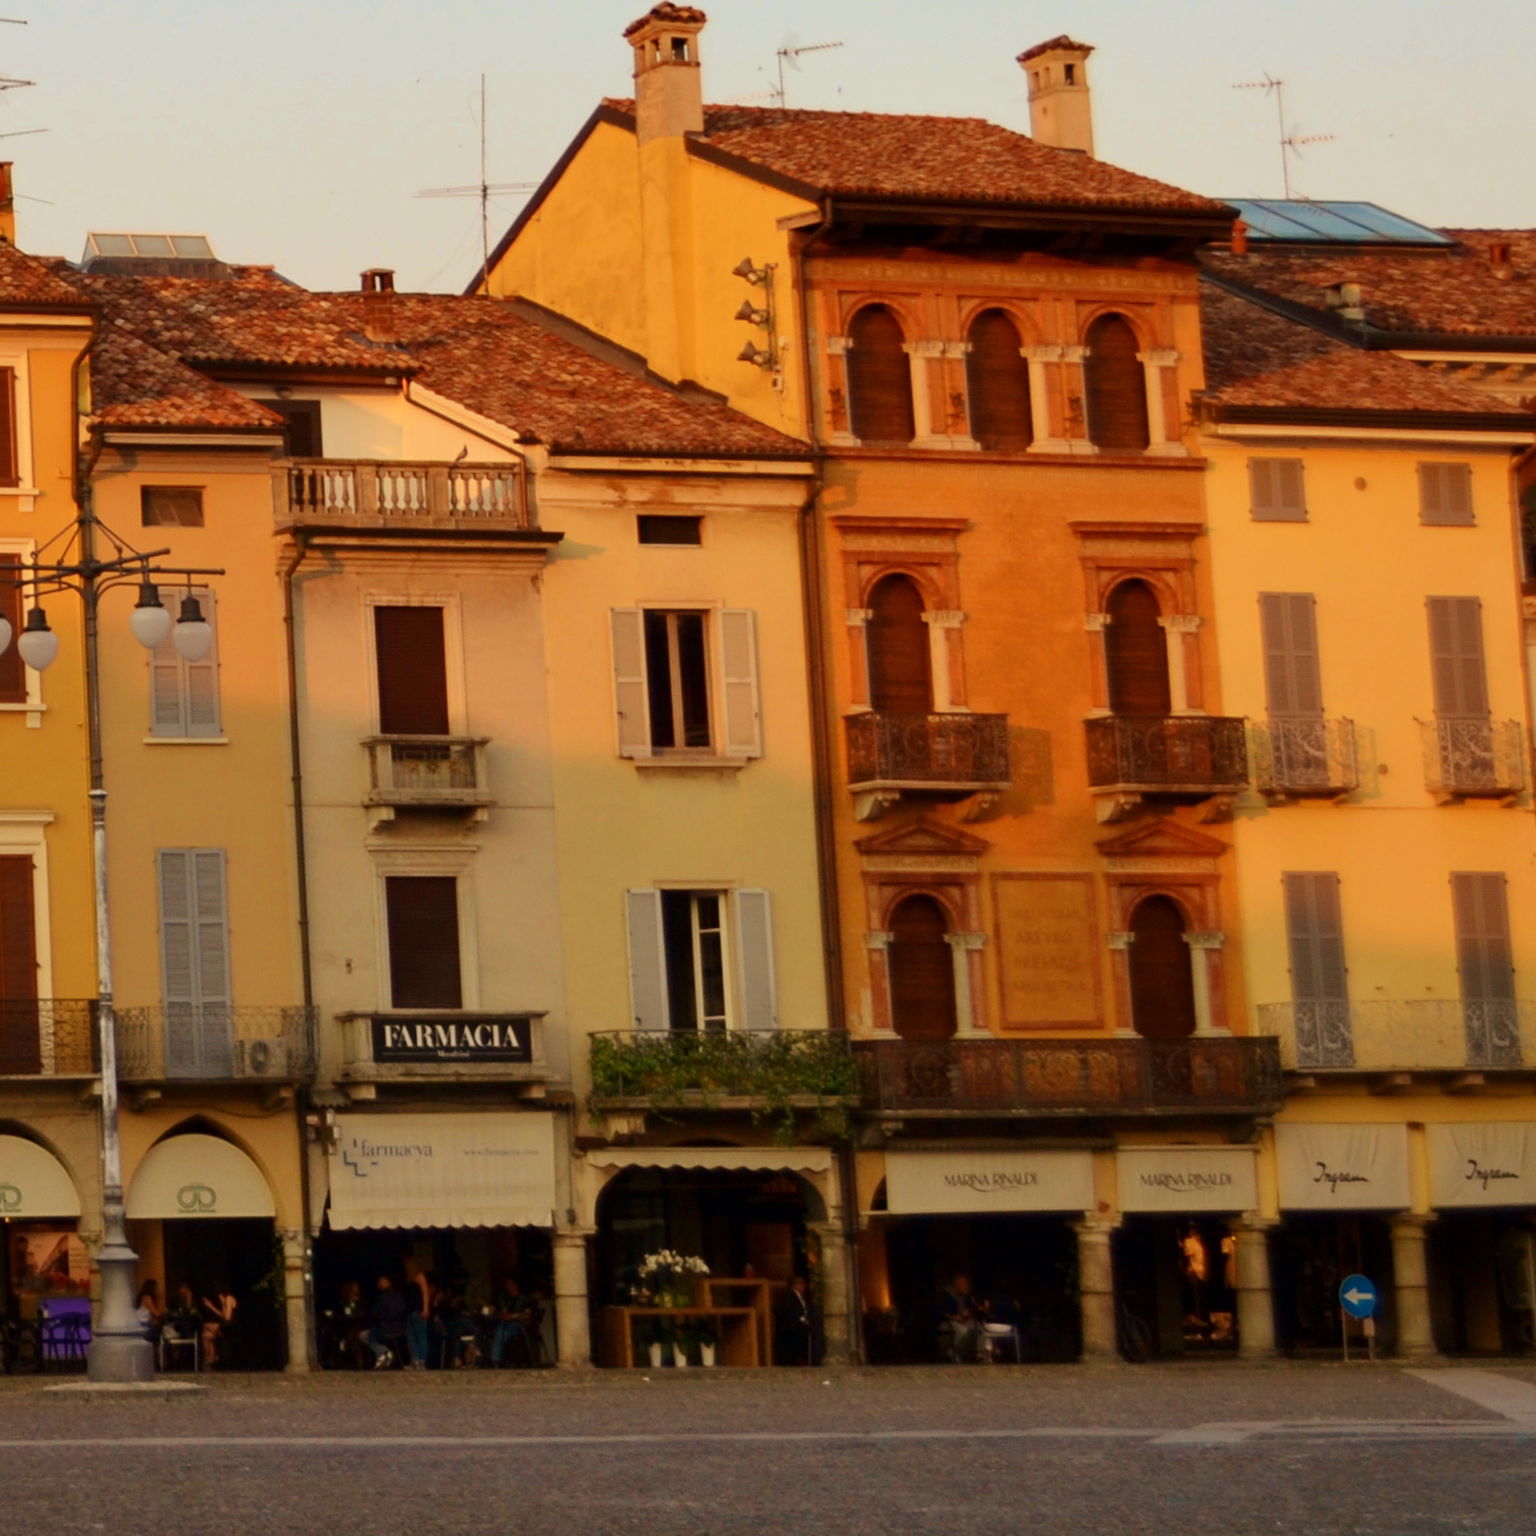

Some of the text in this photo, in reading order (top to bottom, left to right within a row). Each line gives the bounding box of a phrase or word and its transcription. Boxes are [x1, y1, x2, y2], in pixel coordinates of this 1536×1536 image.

[383, 1024, 520, 1048] FARMACIA
[944, 1170, 1038, 1189] MARINA RINALDI
[1139, 1171, 1233, 1189] MARINA RINALDI
